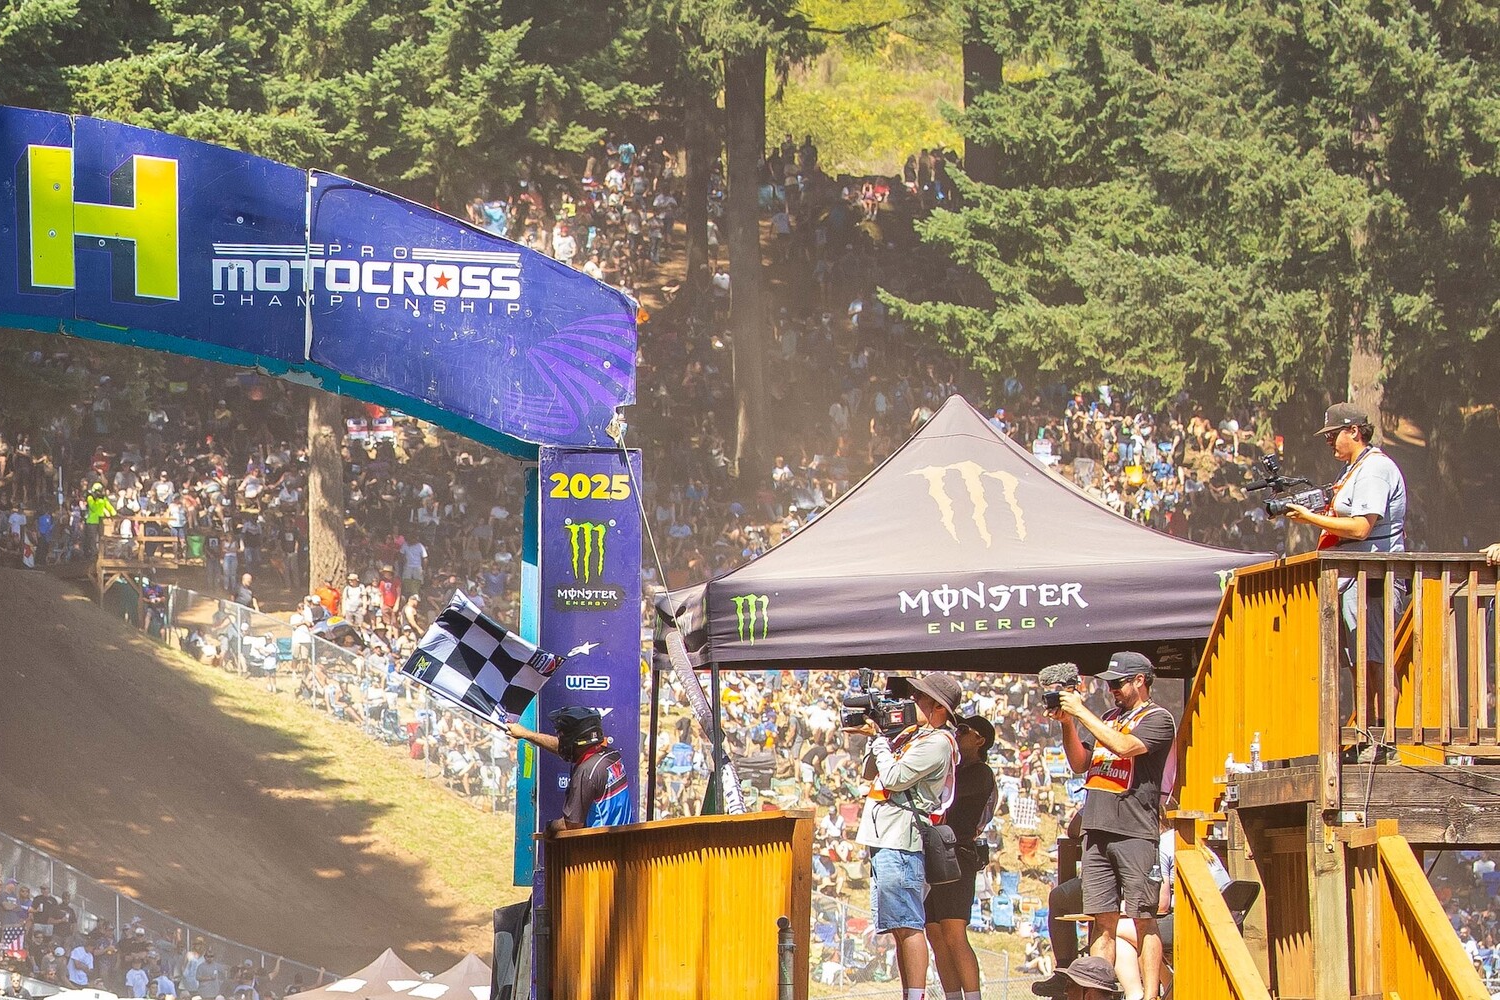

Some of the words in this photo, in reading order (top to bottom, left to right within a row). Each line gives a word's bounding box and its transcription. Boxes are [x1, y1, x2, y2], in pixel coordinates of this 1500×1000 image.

[329, 244, 408, 260] PRO
[212, 258, 521, 300] MOTOCROSS
[212, 293, 520, 316] CHAMPIONSHIP
[549, 472, 632, 500] 2025
[557, 587, 619, 600] MONSTER
[898, 581, 1089, 618] MONSTER
[927, 616, 1060, 635] ENERGY
[565, 675, 610, 692] WPS
